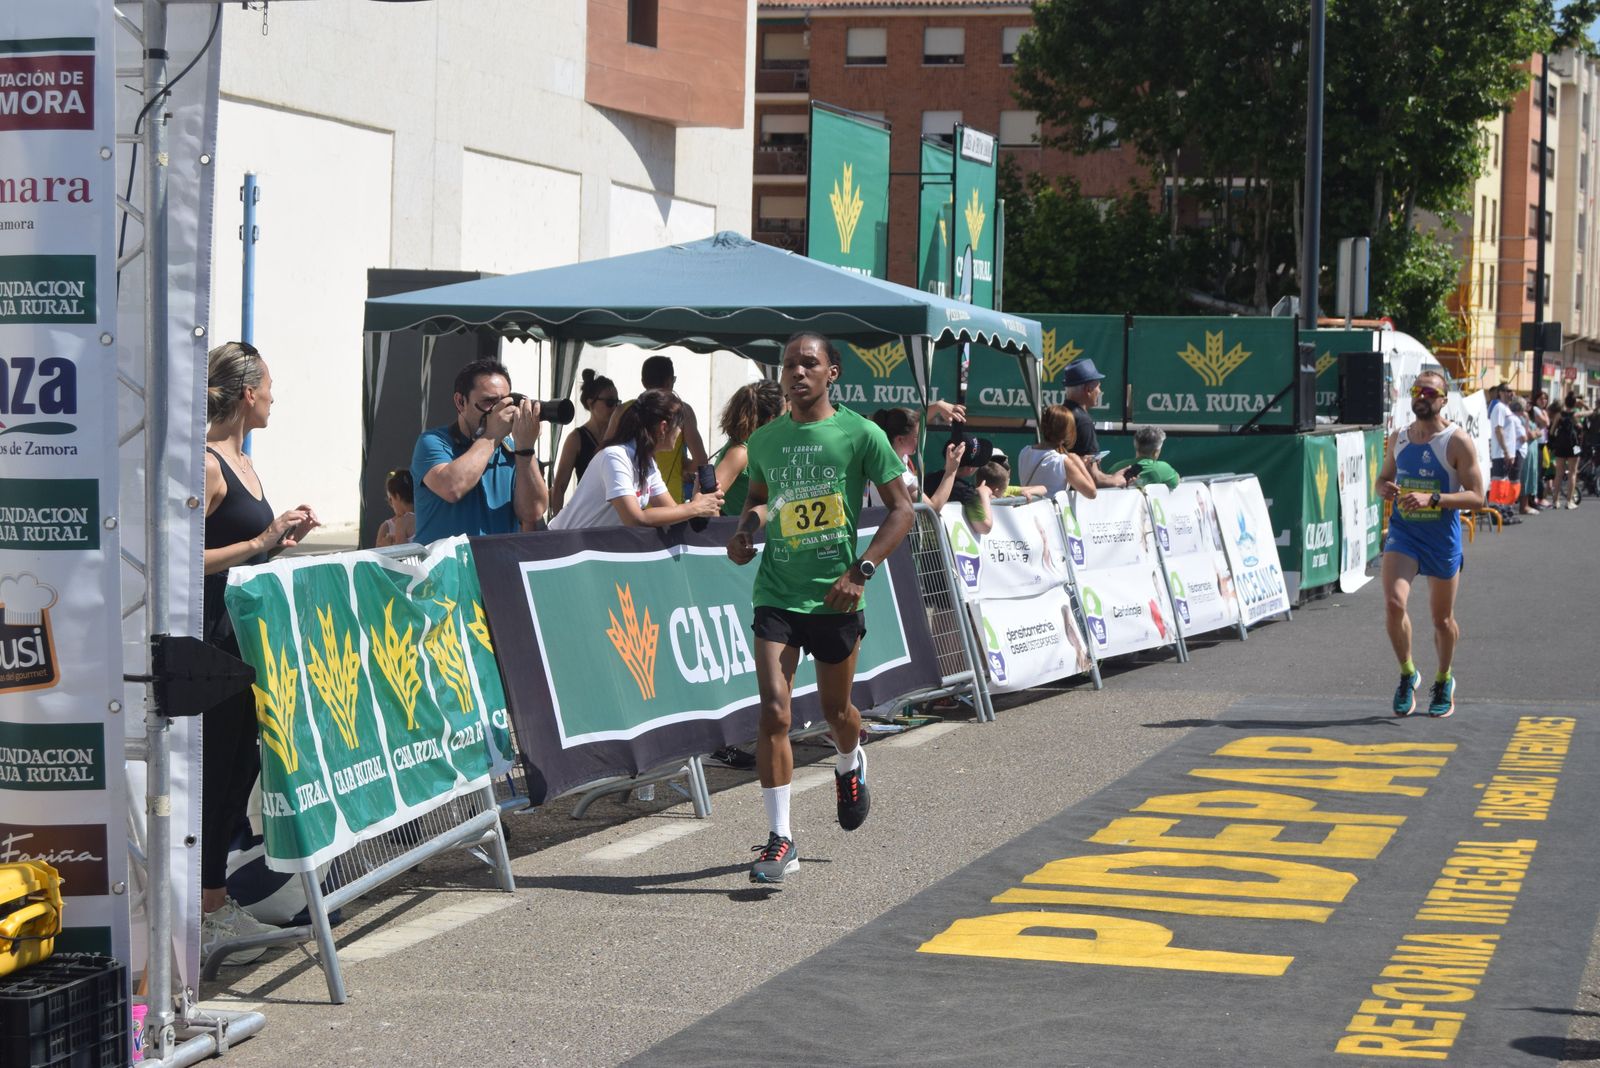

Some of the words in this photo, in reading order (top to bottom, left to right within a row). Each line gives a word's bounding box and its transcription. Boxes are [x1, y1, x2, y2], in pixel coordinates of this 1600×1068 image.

[0, 69, 55, 87] TACIÓN
[60, 71, 84, 86] DE
[0, 90, 86, 115] MORA
[21, 300, 85, 315] RURAL
[0, 357, 77, 414] za
[828, 384, 867, 403] AJA
[873, 385, 944, 403] RURL
[979, 387, 1031, 407] CAJA
[1041, 390, 1110, 409] RUL
[1147, 393, 1199, 413] CAJA
[1206, 393, 1282, 412] RURAL
[10, 441, 22, 455] de
[25, 441, 78, 456] Zamora
[795, 501, 830, 530] 32
[23, 526, 88, 541] RURAL
[669, 604, 757, 685] CAJA
[15, 669, 48, 682] gourmet
[1496, 716, 1577, 772] INTERIORES
[27, 767, 94, 782] RURAL
[333, 766, 358, 795] CAJA
[353, 755, 387, 787] RURAL
[1473, 775, 1559, 821] DISEÑO
[916, 736, 1458, 976] PIDEPAR
[1415, 839, 1539, 925] INTEGRAL
[1334, 933, 1501, 1060] REFORMA
